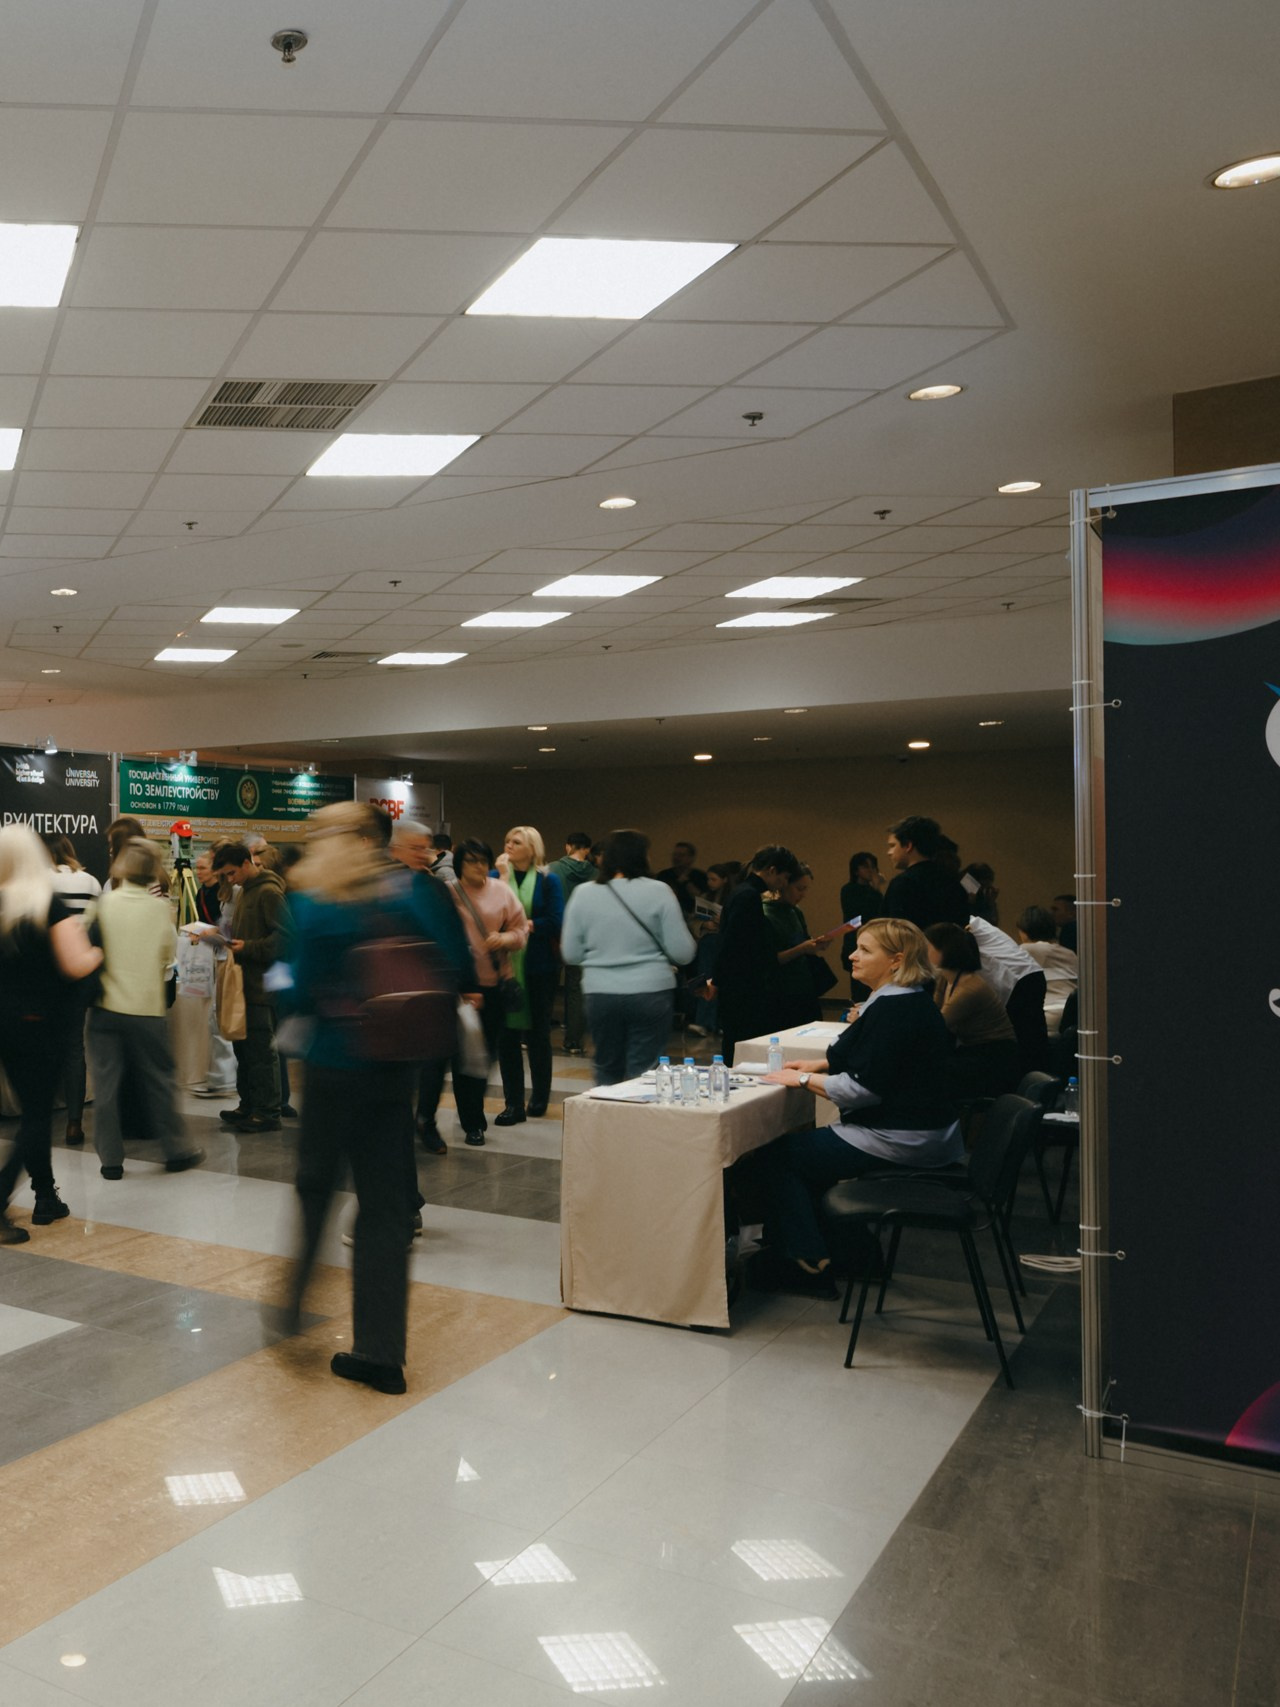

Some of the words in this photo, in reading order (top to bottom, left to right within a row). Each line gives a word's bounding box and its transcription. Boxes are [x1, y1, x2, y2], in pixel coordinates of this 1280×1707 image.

[65, 767, 98, 779] UNIVERSAL
[65, 778, 100, 788] UNIVERSITY
[129, 783, 143, 796] ПО
[145, 784, 220, 801] ЗЕМЛЕУСТРОЙСТВУ
[163, 802, 177, 811] 1779
